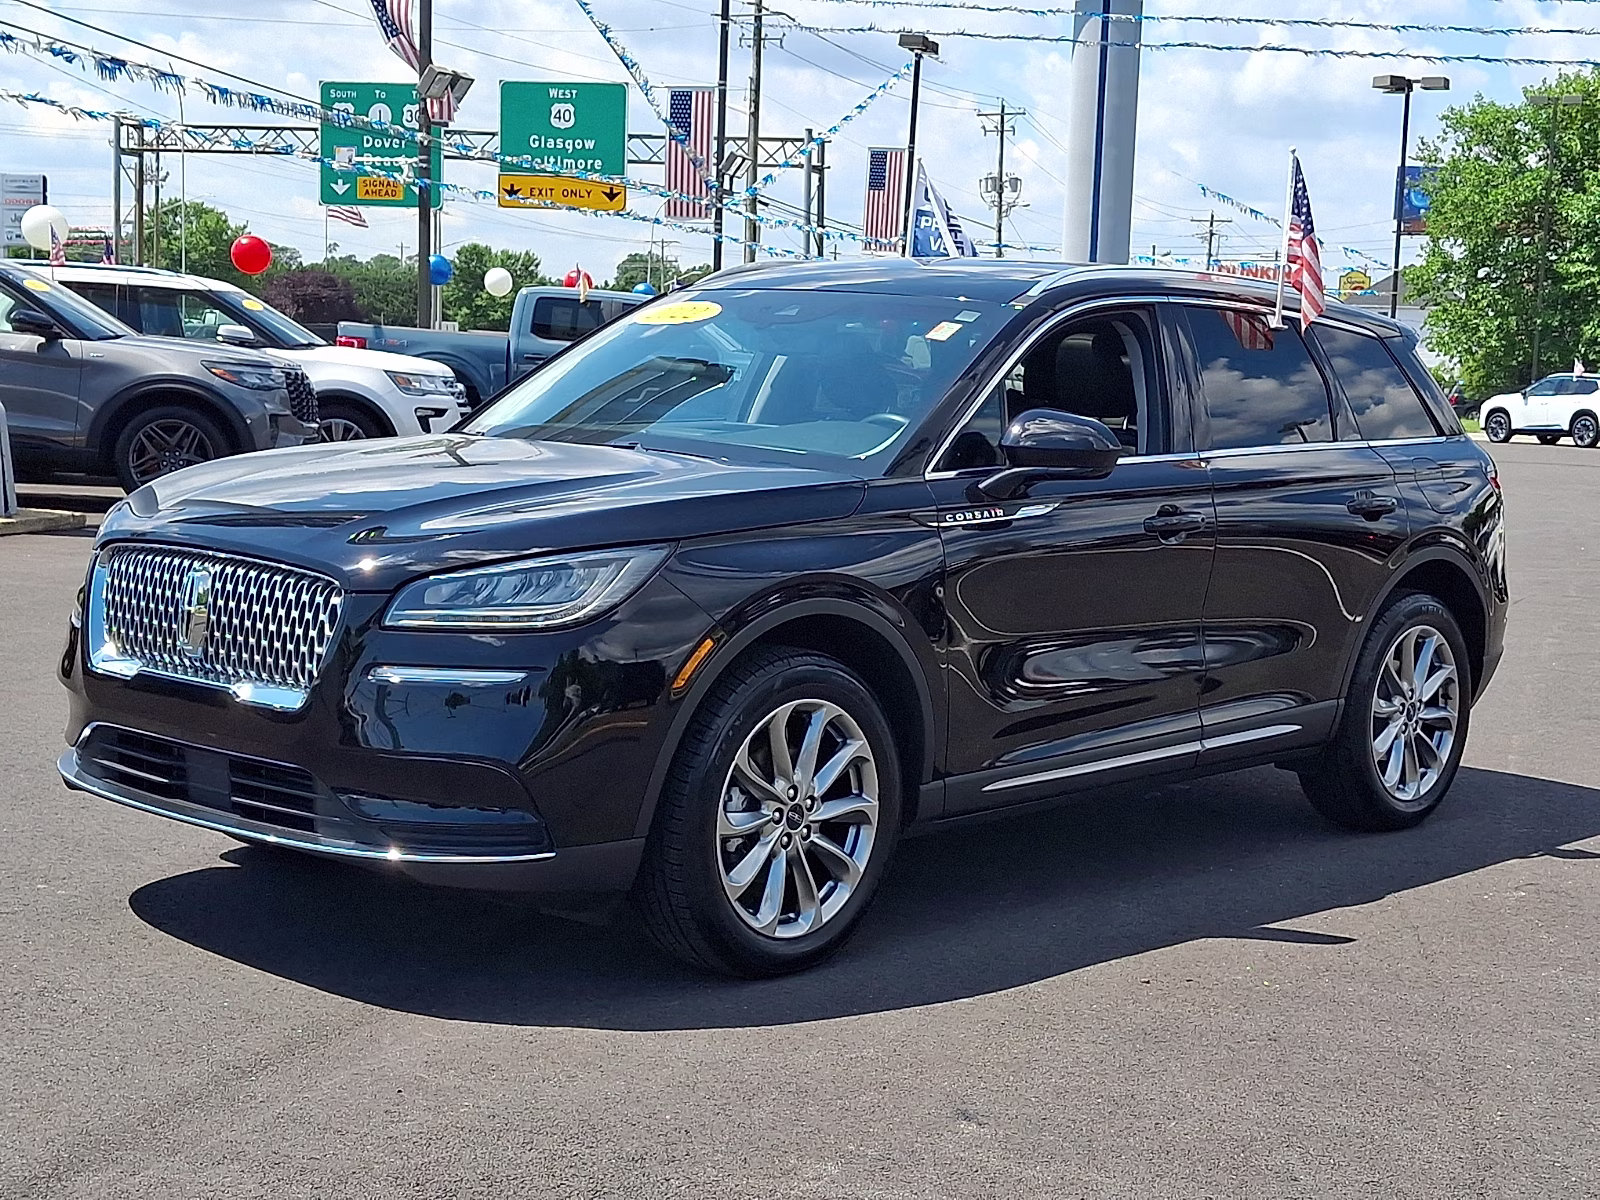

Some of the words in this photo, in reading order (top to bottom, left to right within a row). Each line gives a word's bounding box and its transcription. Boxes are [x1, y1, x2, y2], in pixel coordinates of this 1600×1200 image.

[330, 89, 357, 98] SOUTH
[549, 88, 578, 98] WEST
[553, 108, 572, 122] 40
[363, 135, 406, 148] Dover
[529, 134, 596, 153] Glasgow
[362, 179, 398, 188] SIGNAL
[363, 189, 398, 198] AHEAD
[530, 188, 554, 197] EXIT
[562, 189, 592, 198] ONLY
[945, 508, 1004, 522] CORSAIR
